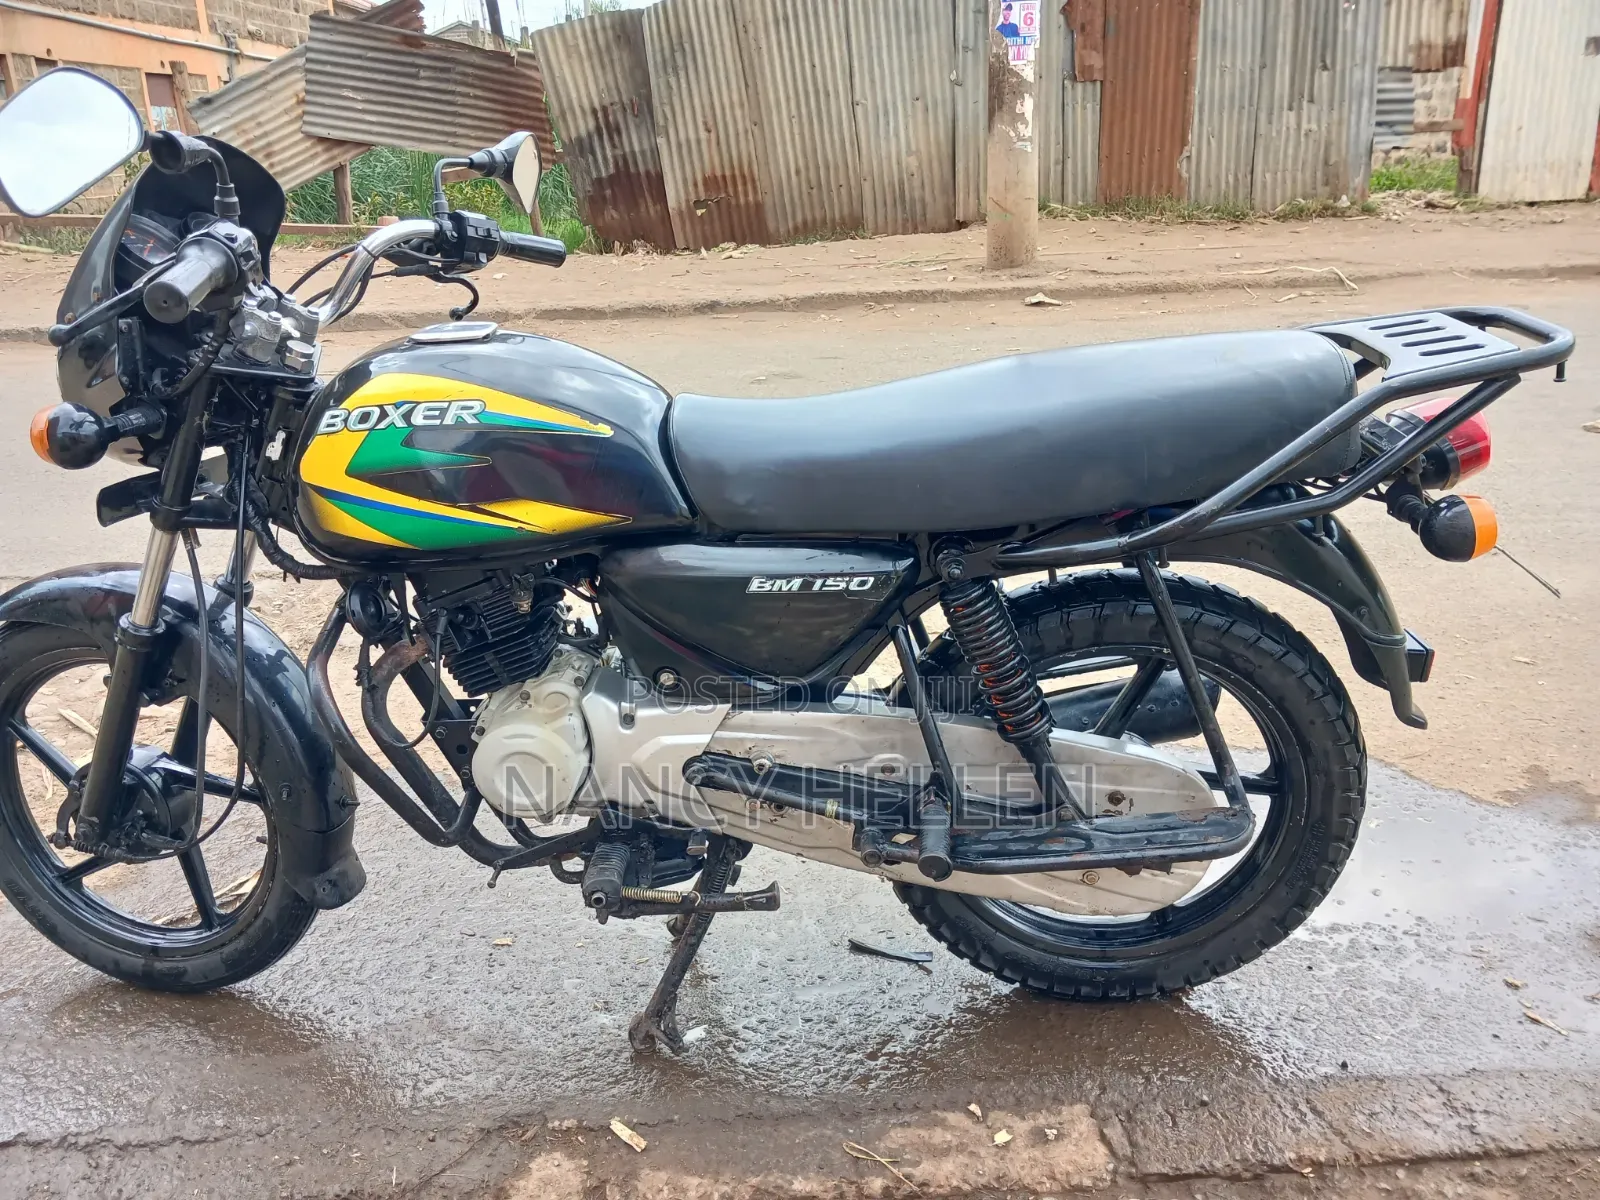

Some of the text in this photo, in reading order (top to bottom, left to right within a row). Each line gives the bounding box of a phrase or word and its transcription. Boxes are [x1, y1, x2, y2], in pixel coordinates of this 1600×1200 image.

[1023, 12, 1034, 26] 6
[317, 400, 485, 435] BOXER
[747, 576, 875, 592] BM 150
